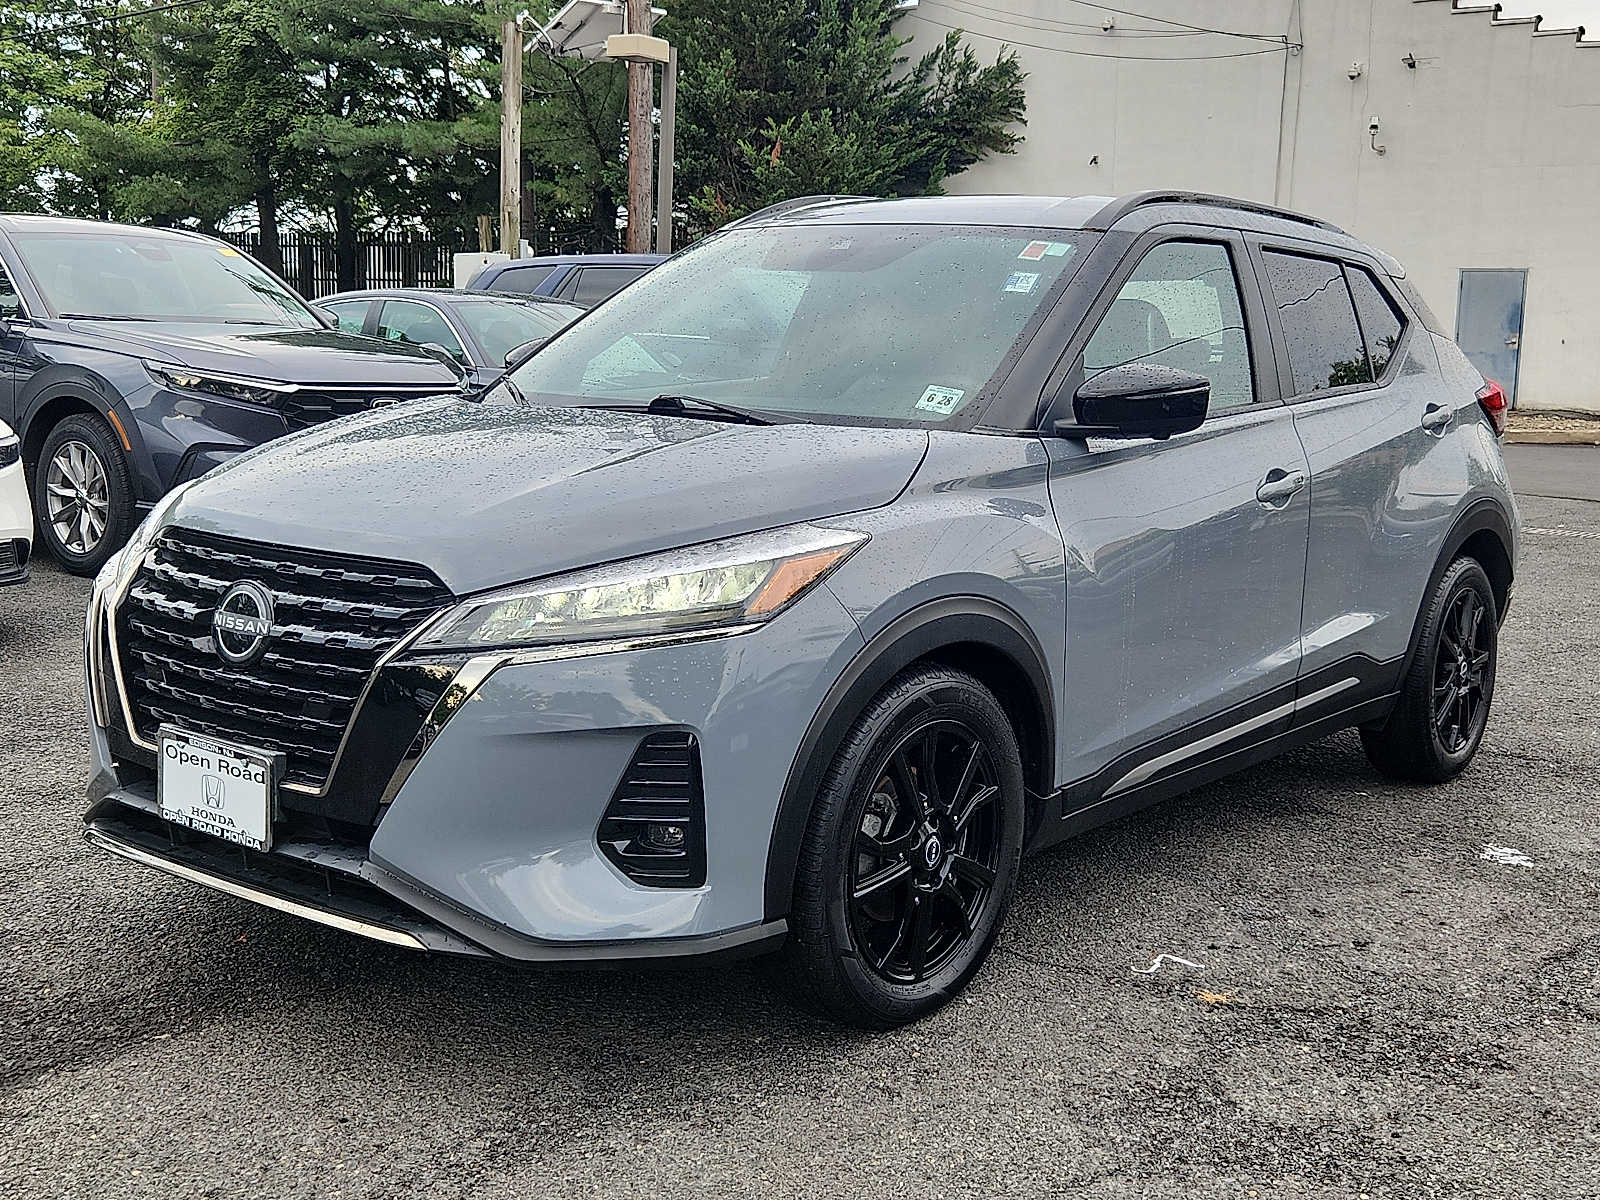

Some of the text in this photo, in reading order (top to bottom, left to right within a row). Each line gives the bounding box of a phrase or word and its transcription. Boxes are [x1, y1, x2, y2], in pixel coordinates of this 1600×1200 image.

[927, 393, 954, 406] 6 28
[214, 611, 269, 634] NISSAN
[165, 744, 266, 784] Open Road
[222, 748, 235, 758] NJ
[191, 806, 237, 828] HONDA
[162, 810, 262, 851] OPEN ROAD HONDA
